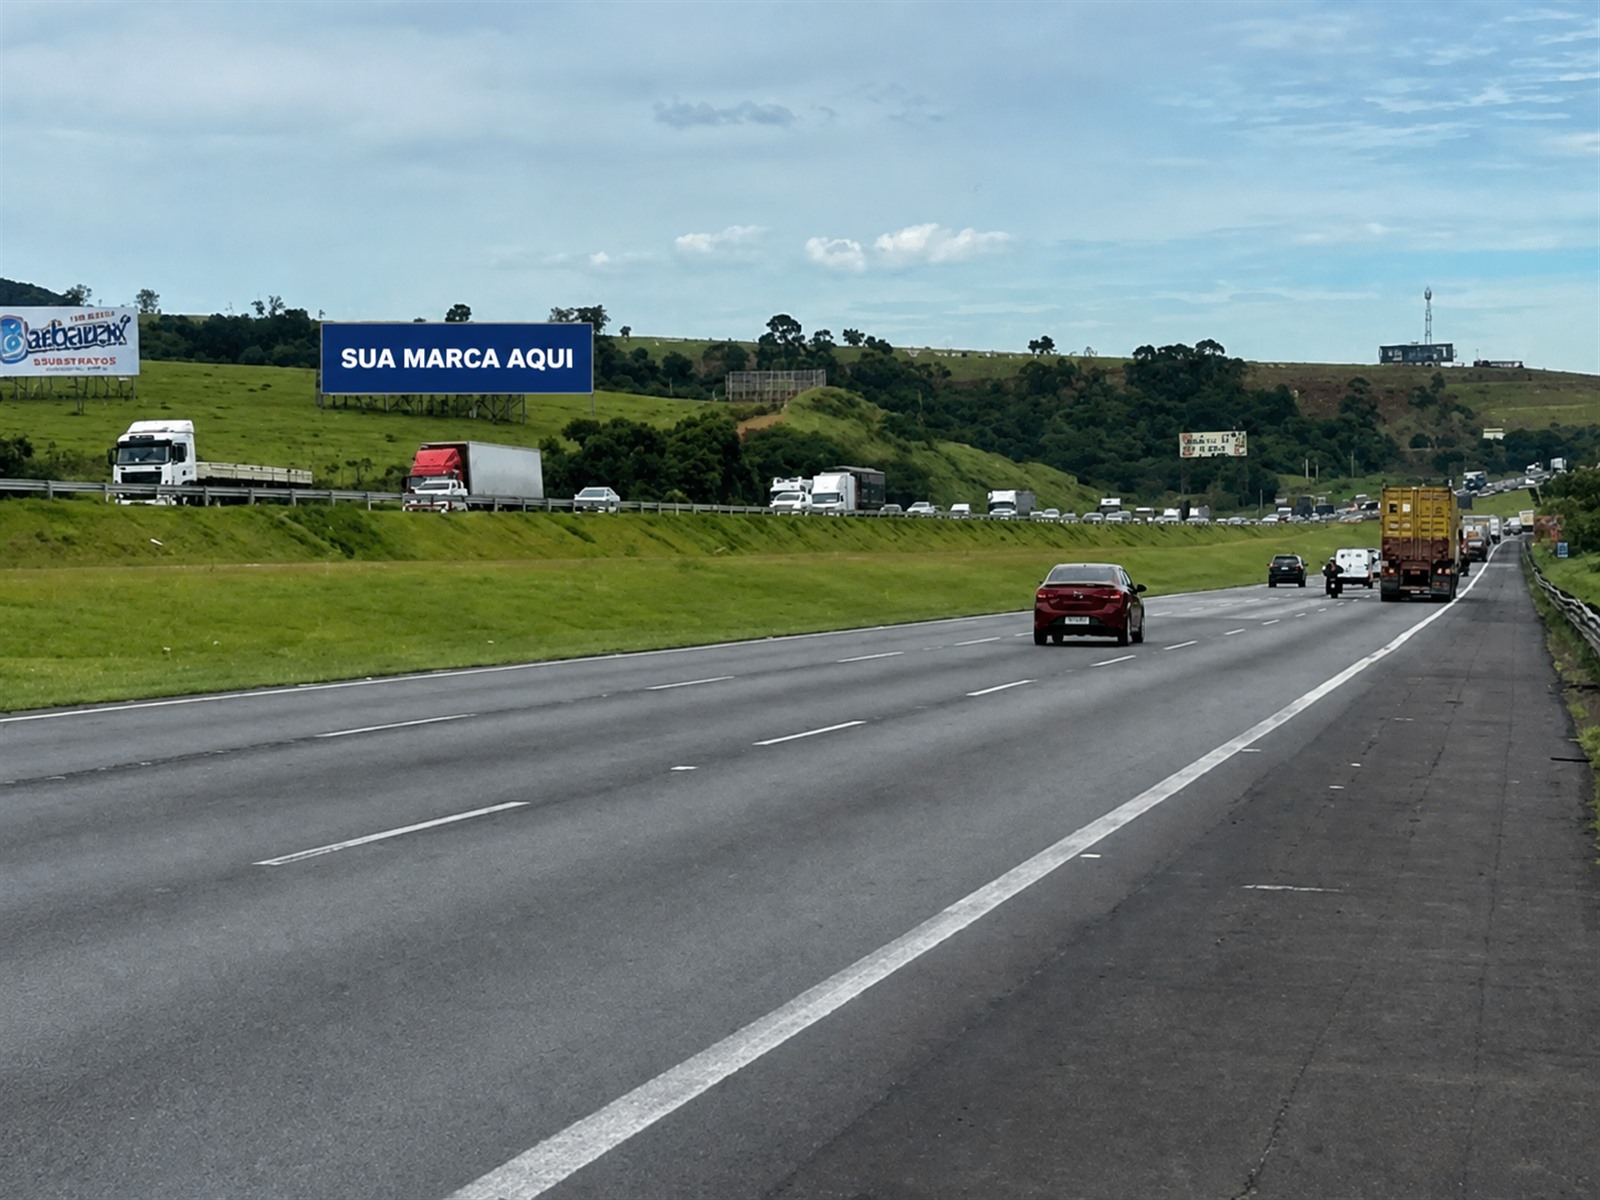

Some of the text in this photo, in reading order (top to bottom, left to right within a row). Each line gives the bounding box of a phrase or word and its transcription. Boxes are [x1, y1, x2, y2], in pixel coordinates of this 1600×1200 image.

[341, 348, 574, 371] SUA MARCA AQUI
